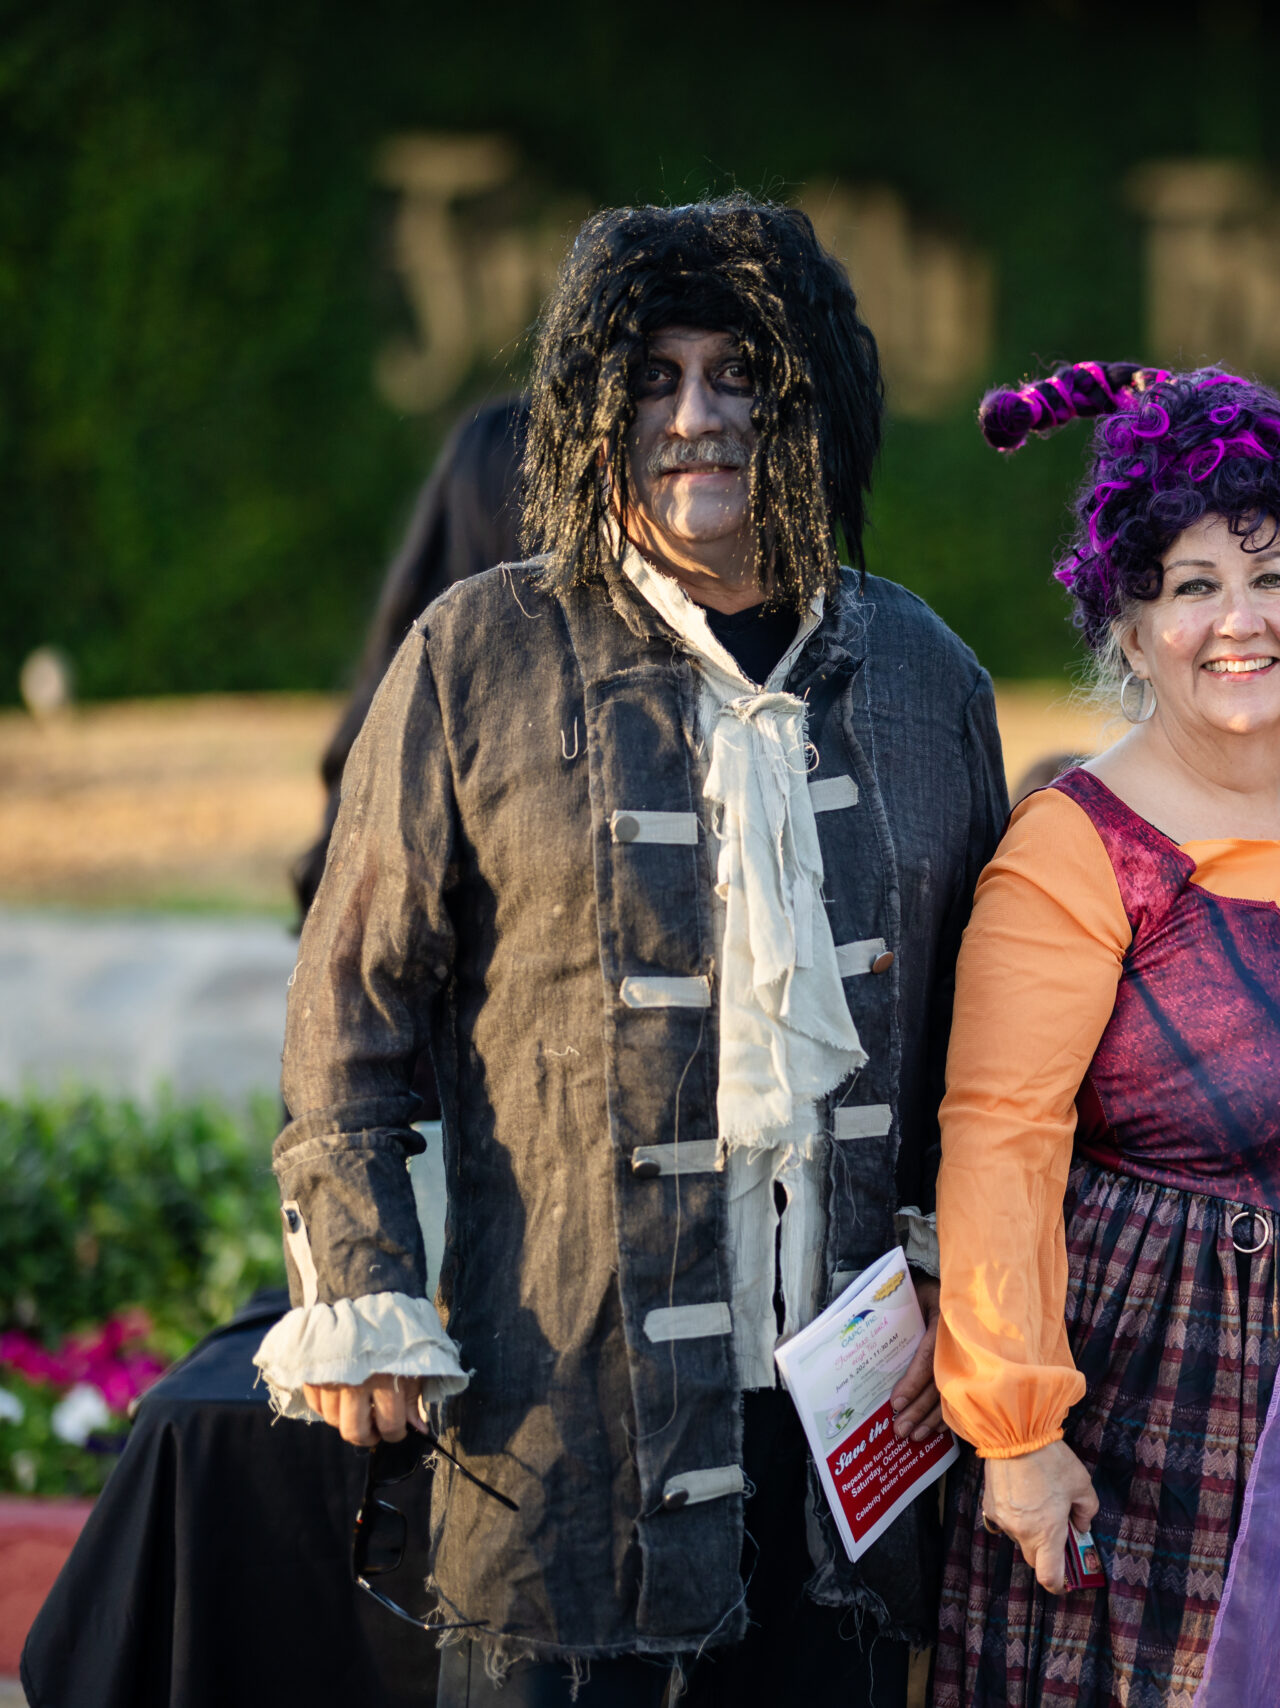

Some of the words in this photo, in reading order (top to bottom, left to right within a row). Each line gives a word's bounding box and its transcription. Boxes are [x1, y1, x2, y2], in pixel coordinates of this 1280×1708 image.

[856, 1359, 869, 1374] 2024
[834, 1438, 867, 1476] Save
[869, 1416, 890, 1442] the
[842, 1469, 863, 1494] Repeat
[862, 1458, 873, 1473] the
[873, 1448, 883, 1463] fun
[883, 1437, 895, 1454] you
[851, 1464, 883, 1498] Saturday,
[883, 1436, 909, 1467] October
[879, 1470, 888, 1484] for
[888, 1461, 898, 1475] our
[898, 1448, 912, 1464] next
[856, 1494, 881, 1522] Celebrity
[880, 1473, 899, 1496] Waiter
[898, 1454, 918, 1477] Dinner
[918, 1448, 924, 1458] &
[925, 1431, 943, 1453] Dance
